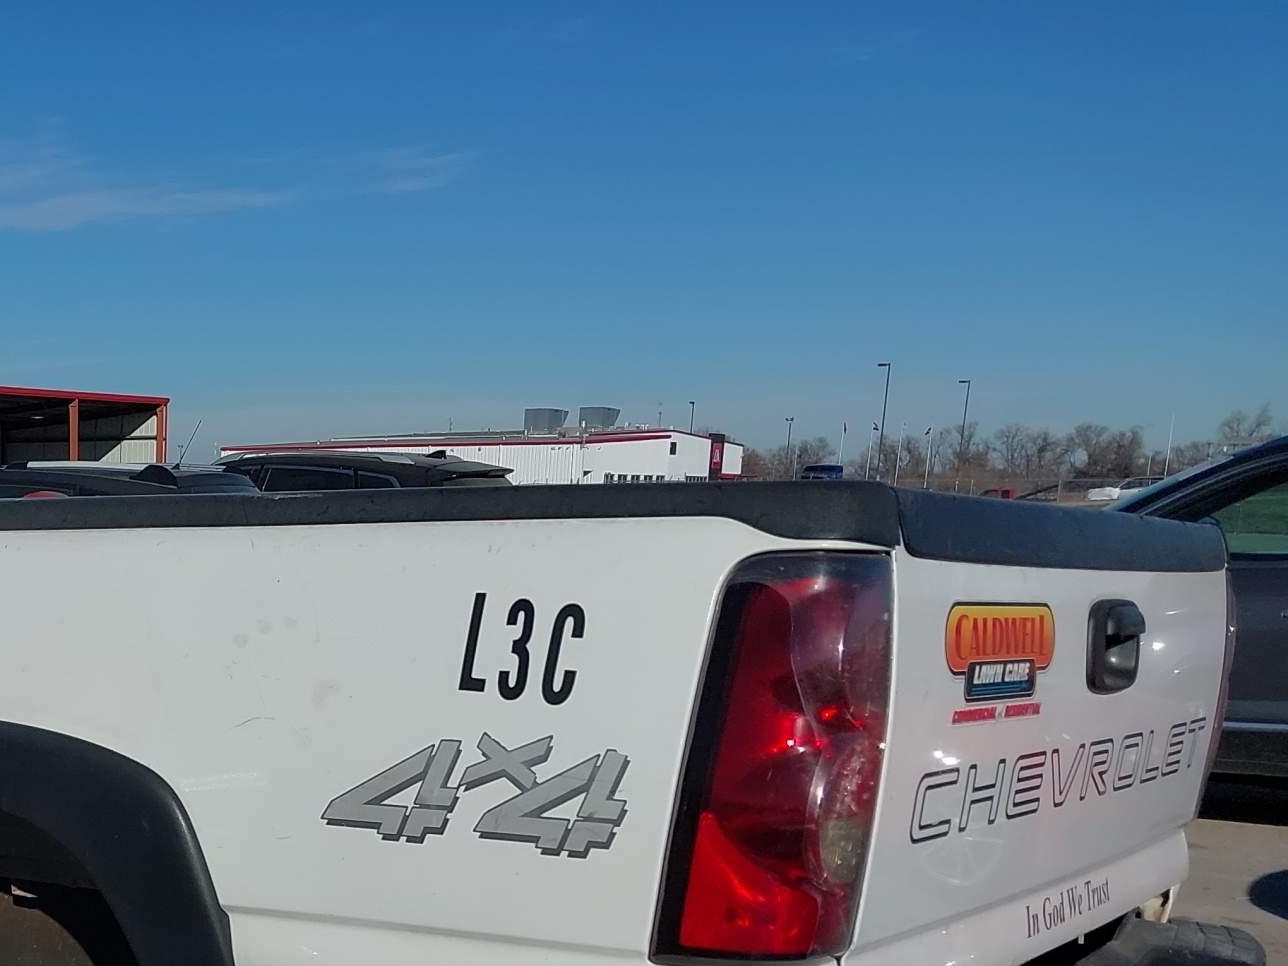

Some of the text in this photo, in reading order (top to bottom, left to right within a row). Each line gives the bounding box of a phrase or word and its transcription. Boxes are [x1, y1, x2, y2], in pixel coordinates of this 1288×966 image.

[458, 592, 586, 706] L3C
[955, 614, 1047, 661] CALDWELL
[911, 717, 1208, 845] CHEVROLET
[1026, 879, 1111, 938] In God We Trust
